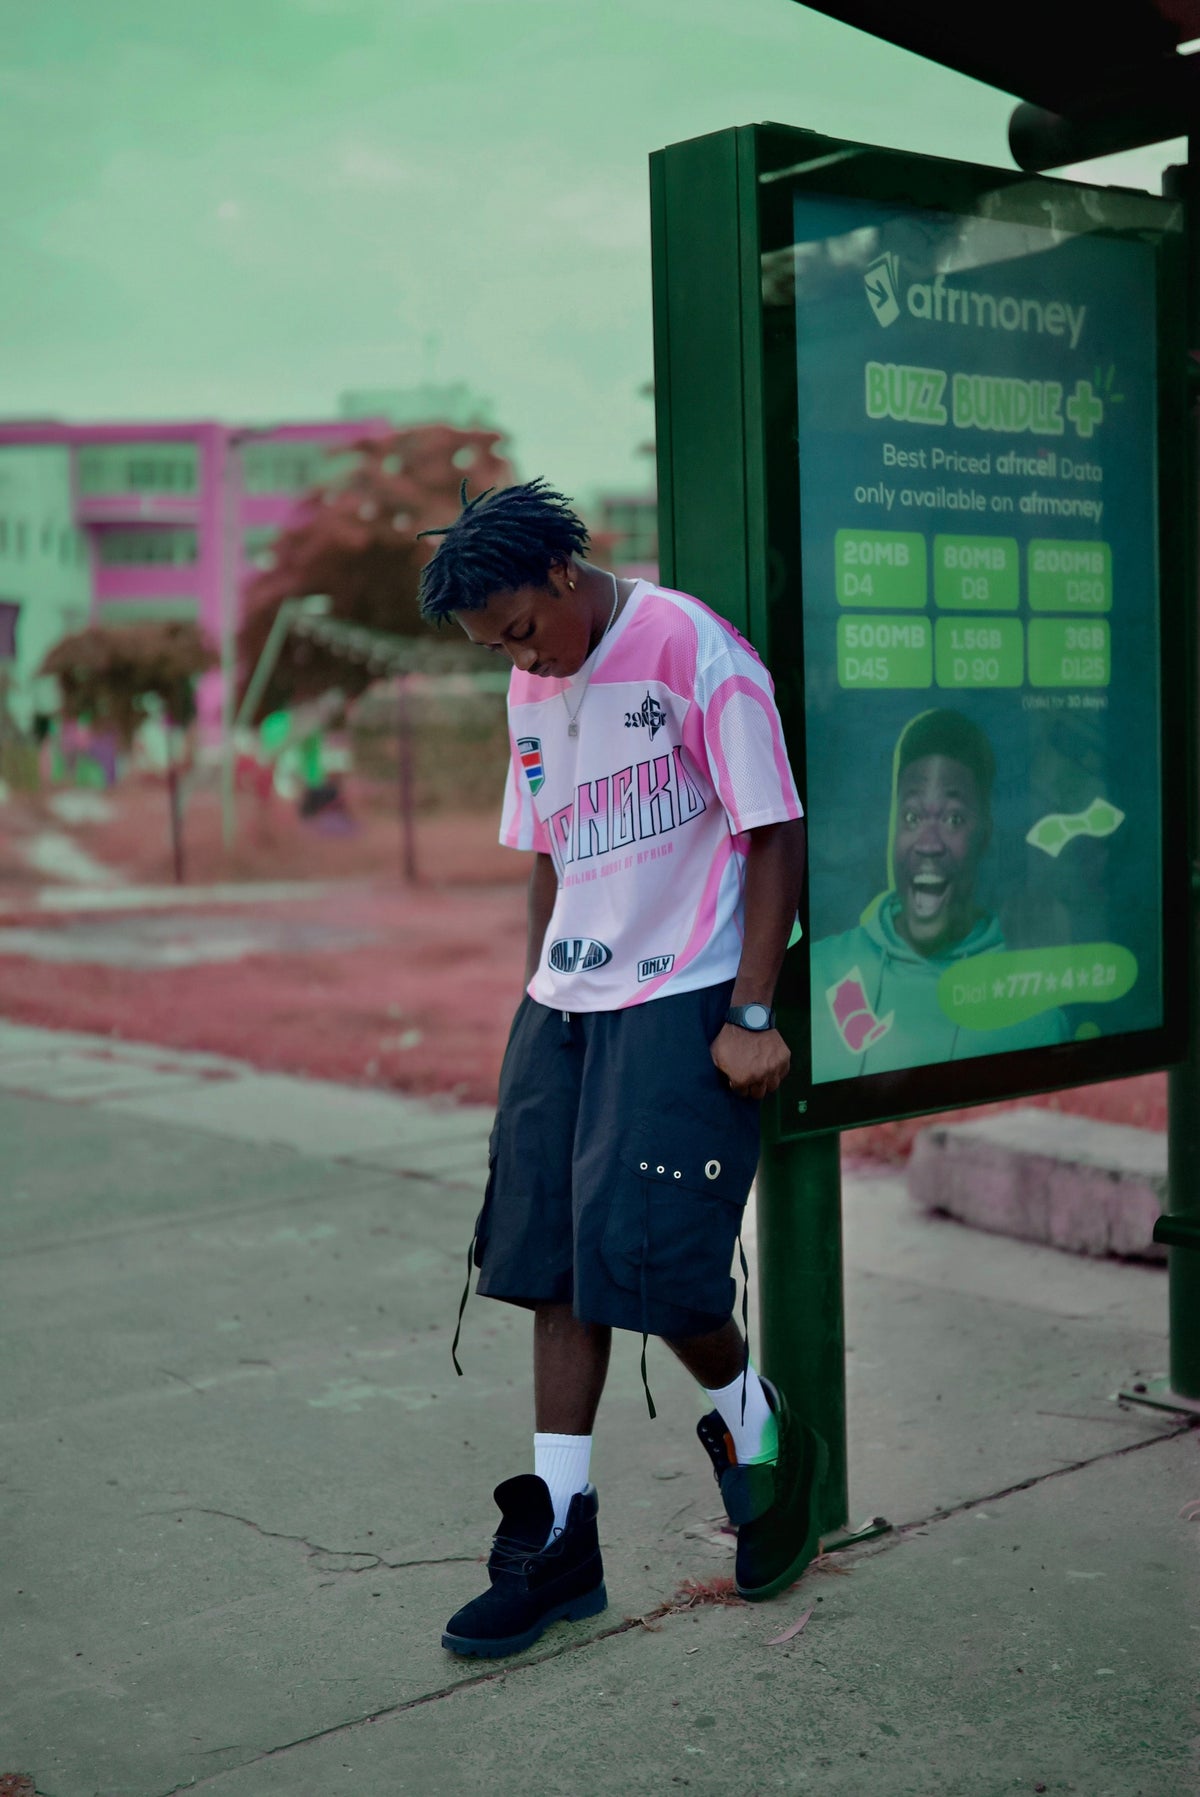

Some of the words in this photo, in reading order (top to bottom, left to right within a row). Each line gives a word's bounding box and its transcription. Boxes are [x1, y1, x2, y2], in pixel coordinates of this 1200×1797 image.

[907, 274, 1085, 349] afrimoney
[865, 362, 947, 426] BUZZ
[883, 443, 926, 469] Best
[931, 449, 990, 474] Priced
[1061, 458, 1102, 482] Data
[855, 483, 895, 510] only
[900, 487, 985, 511] available
[991, 496, 1013, 509] on
[843, 541, 909, 567] 20MB
[944, 546, 1005, 570] 80MB
[1033, 551, 1104, 575] 200MB
[843, 574, 874, 597] D4
[962, 577, 988, 600] D8
[1067, 580, 1104, 603] D20
[845, 624, 925, 649] 500MB
[1065, 627, 1104, 649] 3GB
[845, 658, 888, 681] D45
[642, 957, 671, 977] ONLY
[953, 982, 987, 1007] Dial
